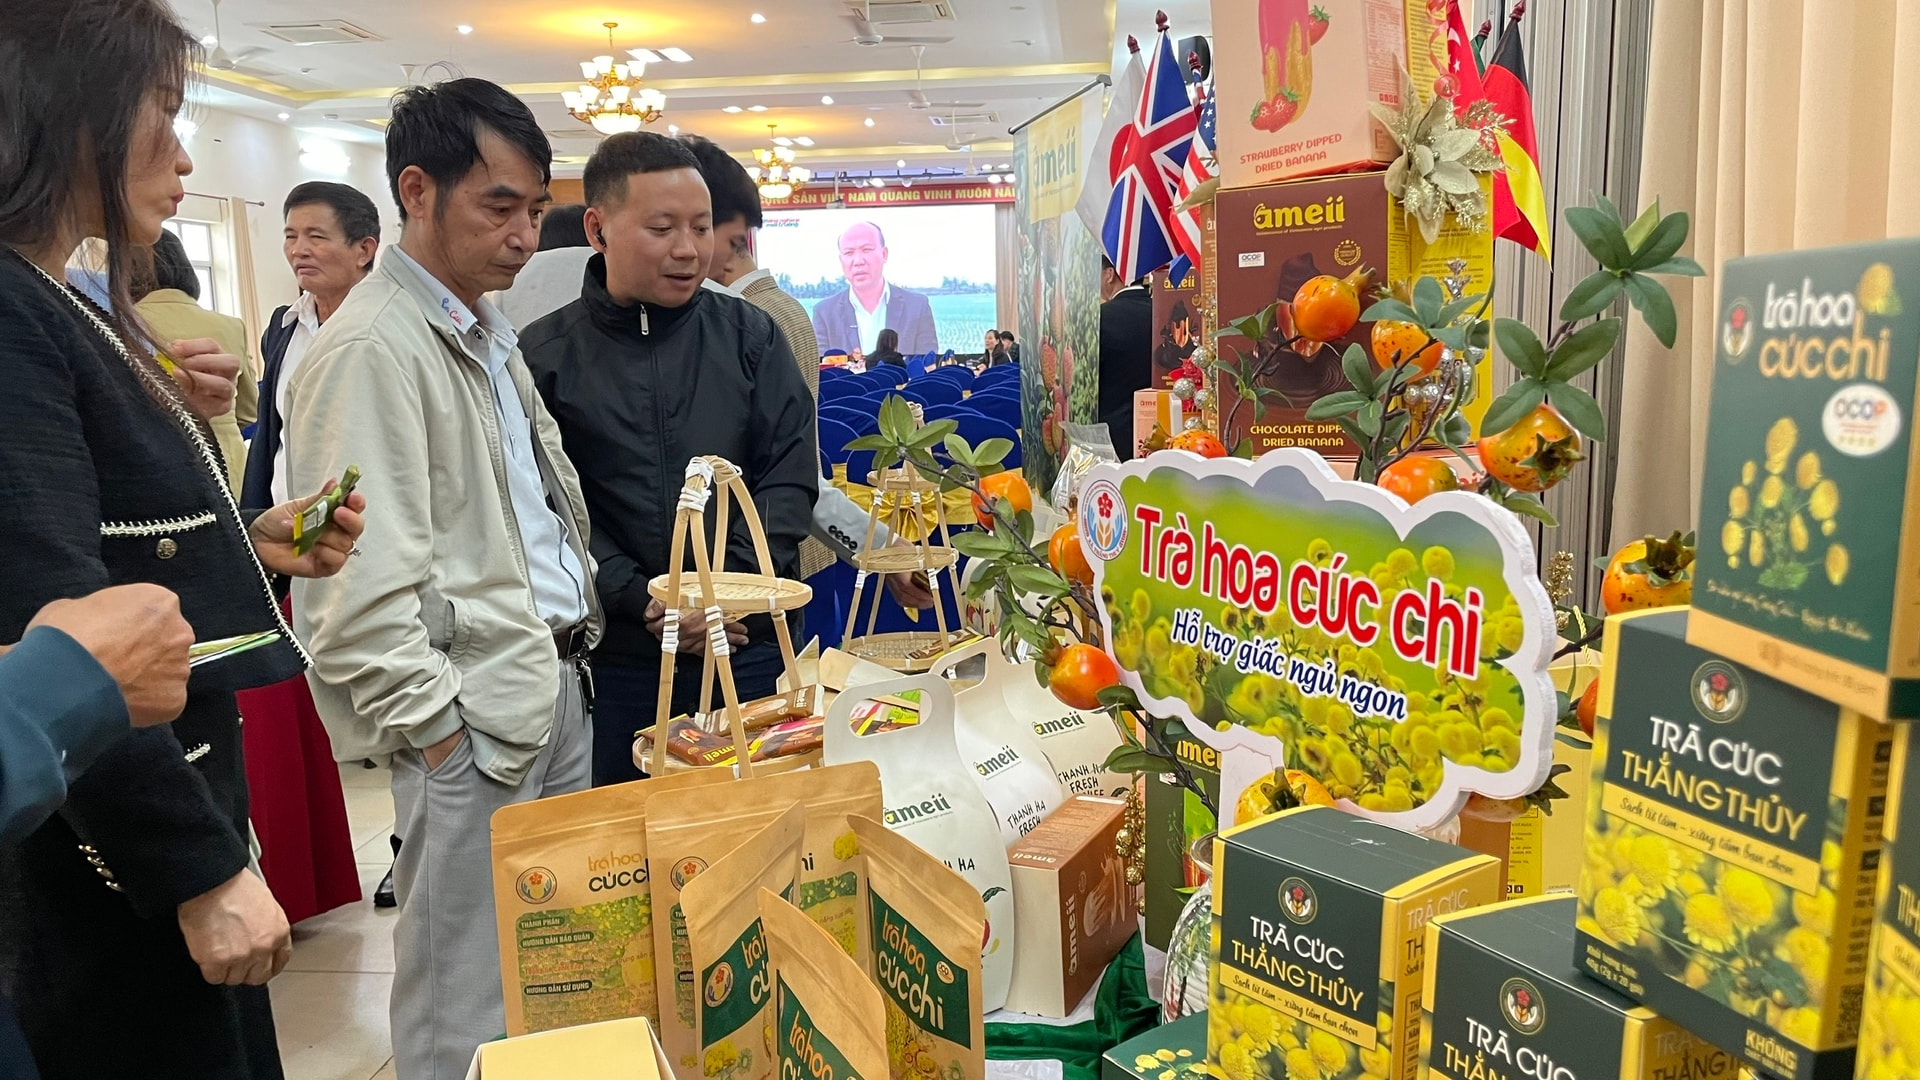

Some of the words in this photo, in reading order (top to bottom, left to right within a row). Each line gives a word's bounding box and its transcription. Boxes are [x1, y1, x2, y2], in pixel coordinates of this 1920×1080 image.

[1240, 142, 1303, 164] STRAWBERRY
[1306, 133, 1342, 149] DIPPED
[1255, 161, 1283, 174] DRIED
[1285, 151, 1327, 167] BANANA
[792, 190, 817, 204] SẢN
[848, 191, 877, 203] NAM
[880, 190, 921, 202] QUANG
[924, 189, 951, 200] VINH
[955, 186, 992, 199] MUÔN
[1834, 398, 1888, 419] OCOP
[1250, 424, 1306, 435] CHOCOLATE
[1308, 425, 1348, 435] DIPP
[1262, 437, 1295, 447] DRIED
[1297, 437, 1345, 447] BANANA
[1136, 507, 1195, 588] Trà
[1202, 522, 1279, 613] hoa
[1290, 554, 1380, 645] cúc
[1393, 579, 1482, 678] chi
[1172, 609, 1200, 645] Hỗ
[1203, 625, 1236, 666] trợ
[1237, 640, 1285, 682] giấc
[1288, 659, 1336, 699] ngủ
[1340, 678, 1408, 721] ngon
[1069, 777, 1099, 794] FRESH
[1007, 804, 1035, 830] THANH
[1035, 800, 1047, 812] HA
[1019, 818, 1042, 837] FRESH
[958, 857, 976, 872] HA
[1293, 935, 1345, 971] CÚC
[1745, 1028, 1798, 1070] KHÔNG
